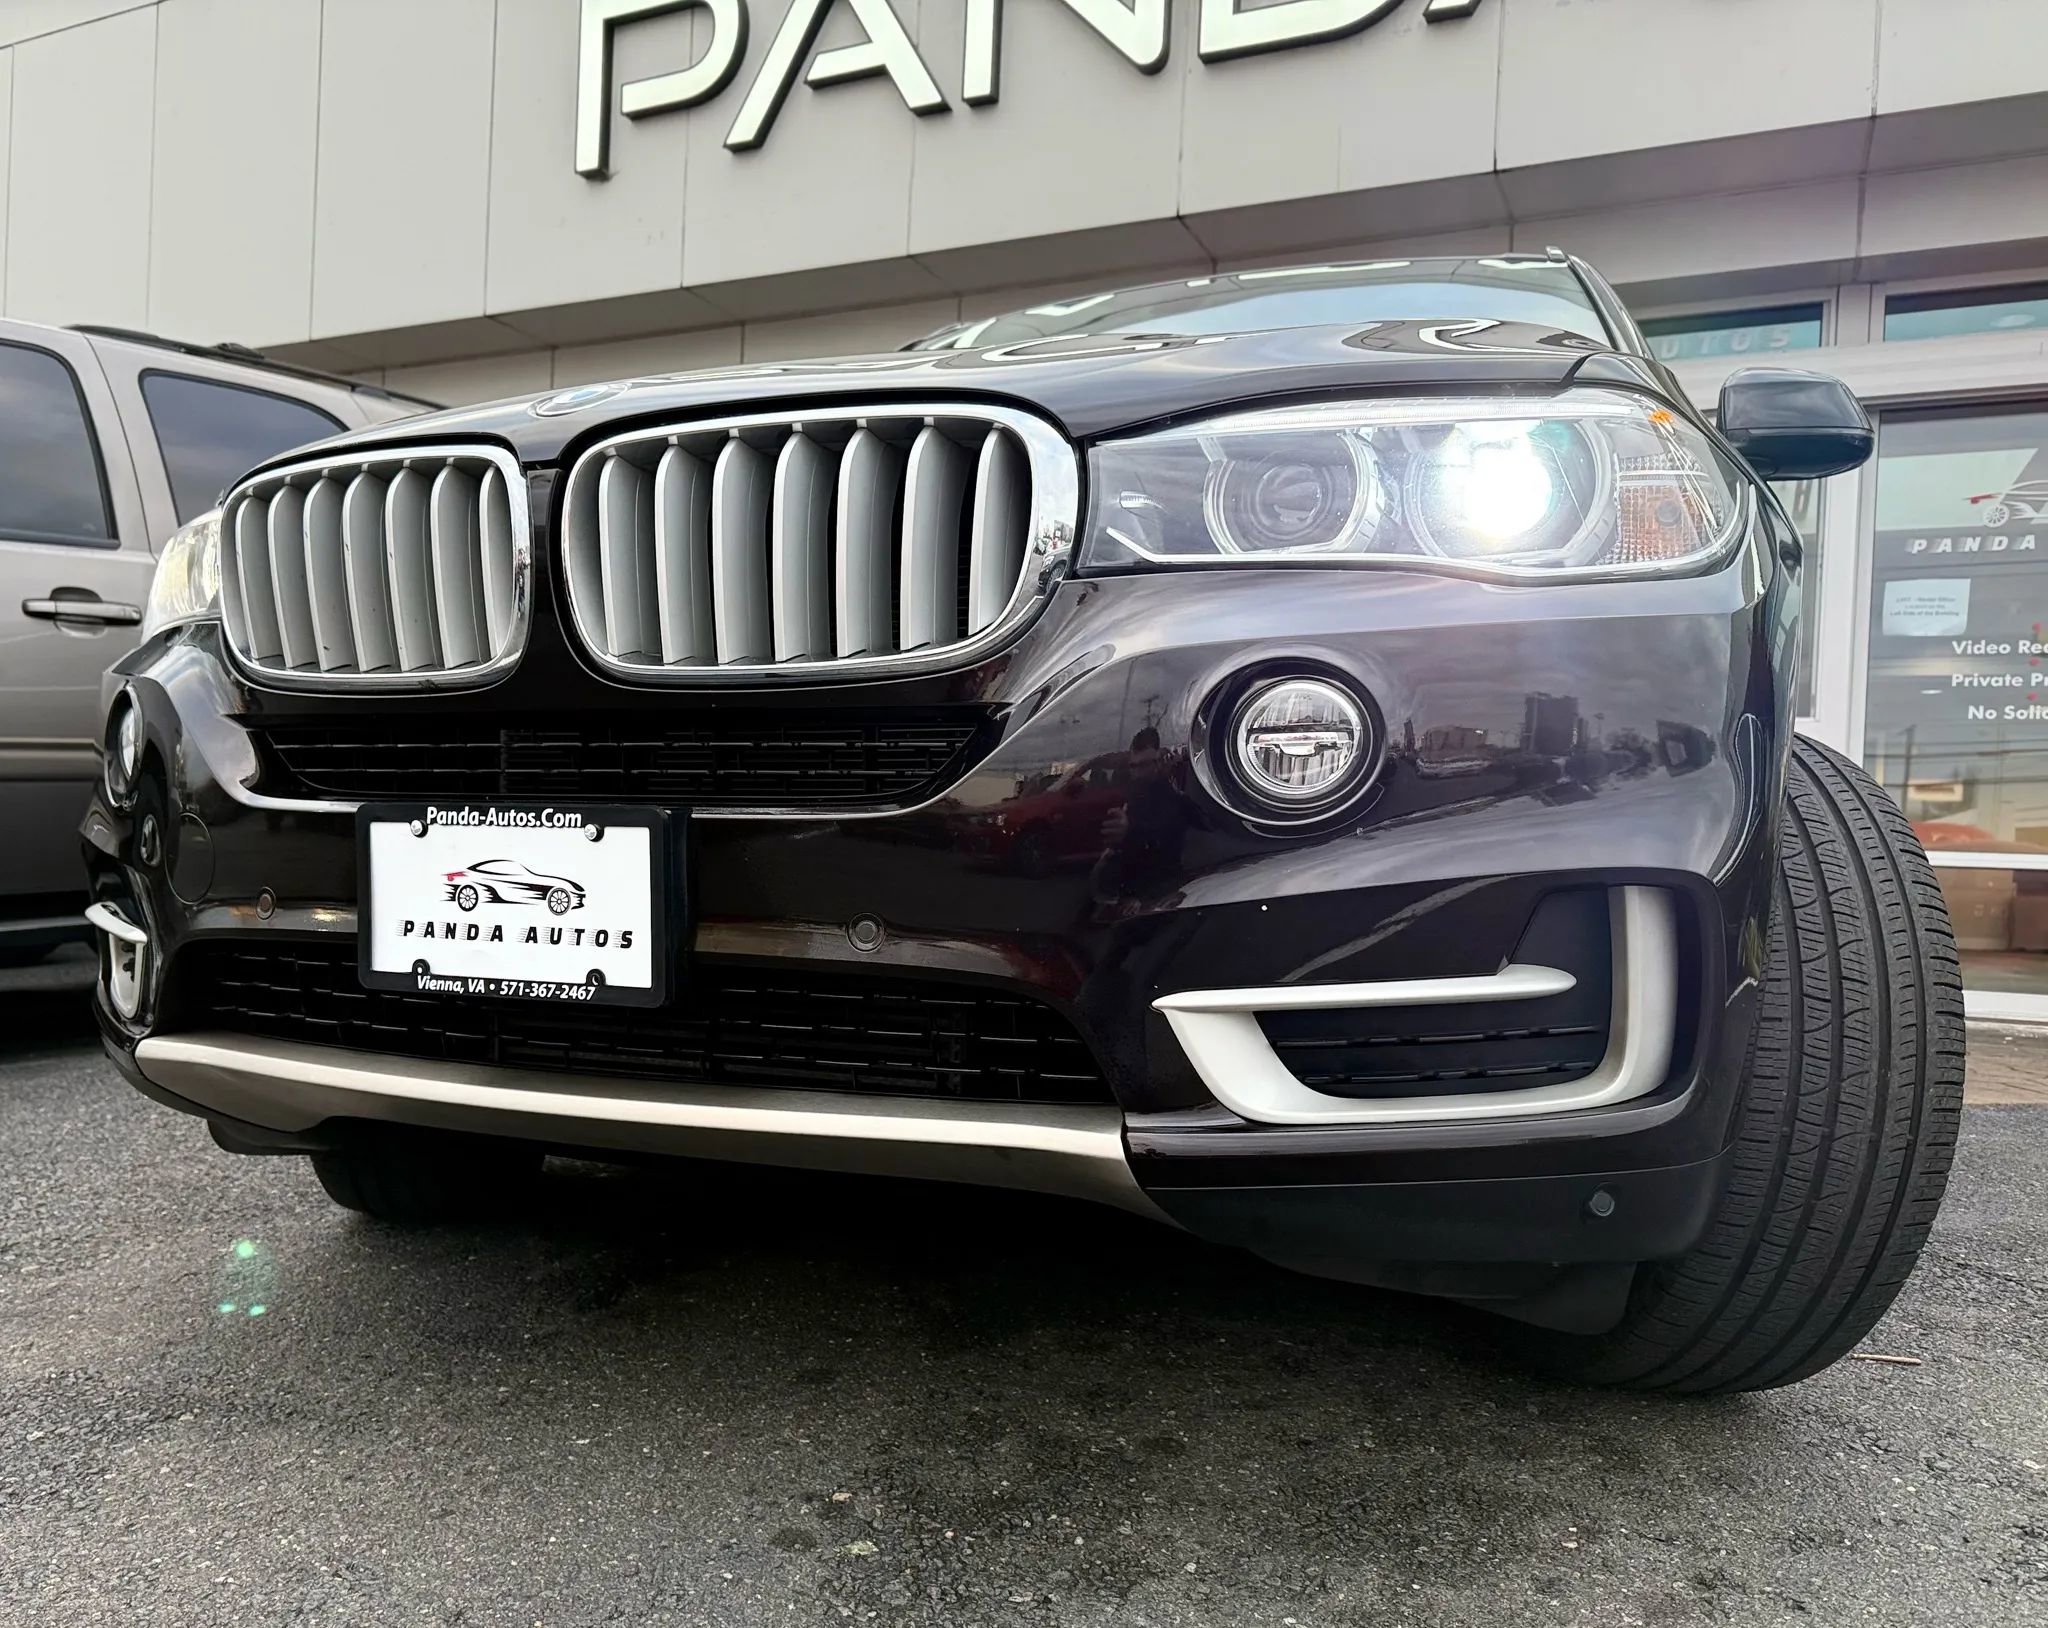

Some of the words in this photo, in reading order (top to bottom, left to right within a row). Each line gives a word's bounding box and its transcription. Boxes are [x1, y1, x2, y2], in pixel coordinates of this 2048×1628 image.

[1661, 328, 1792, 358] UTOS
[1909, 534, 2036, 554] PANDA
[1951, 640, 2011, 655] Video
[1951, 673, 2024, 687] Private
[1967, 705, 1998, 720] No
[426, 805, 582, 828] Panda-Autos.Com
[401, 920, 504, 942] PANDA
[524, 926, 634, 949] AUTOS
[416, 975, 465, 994] Vienna,
[468, 978, 486, 993] VA
[499, 981, 597, 1001] 571-367-2467
